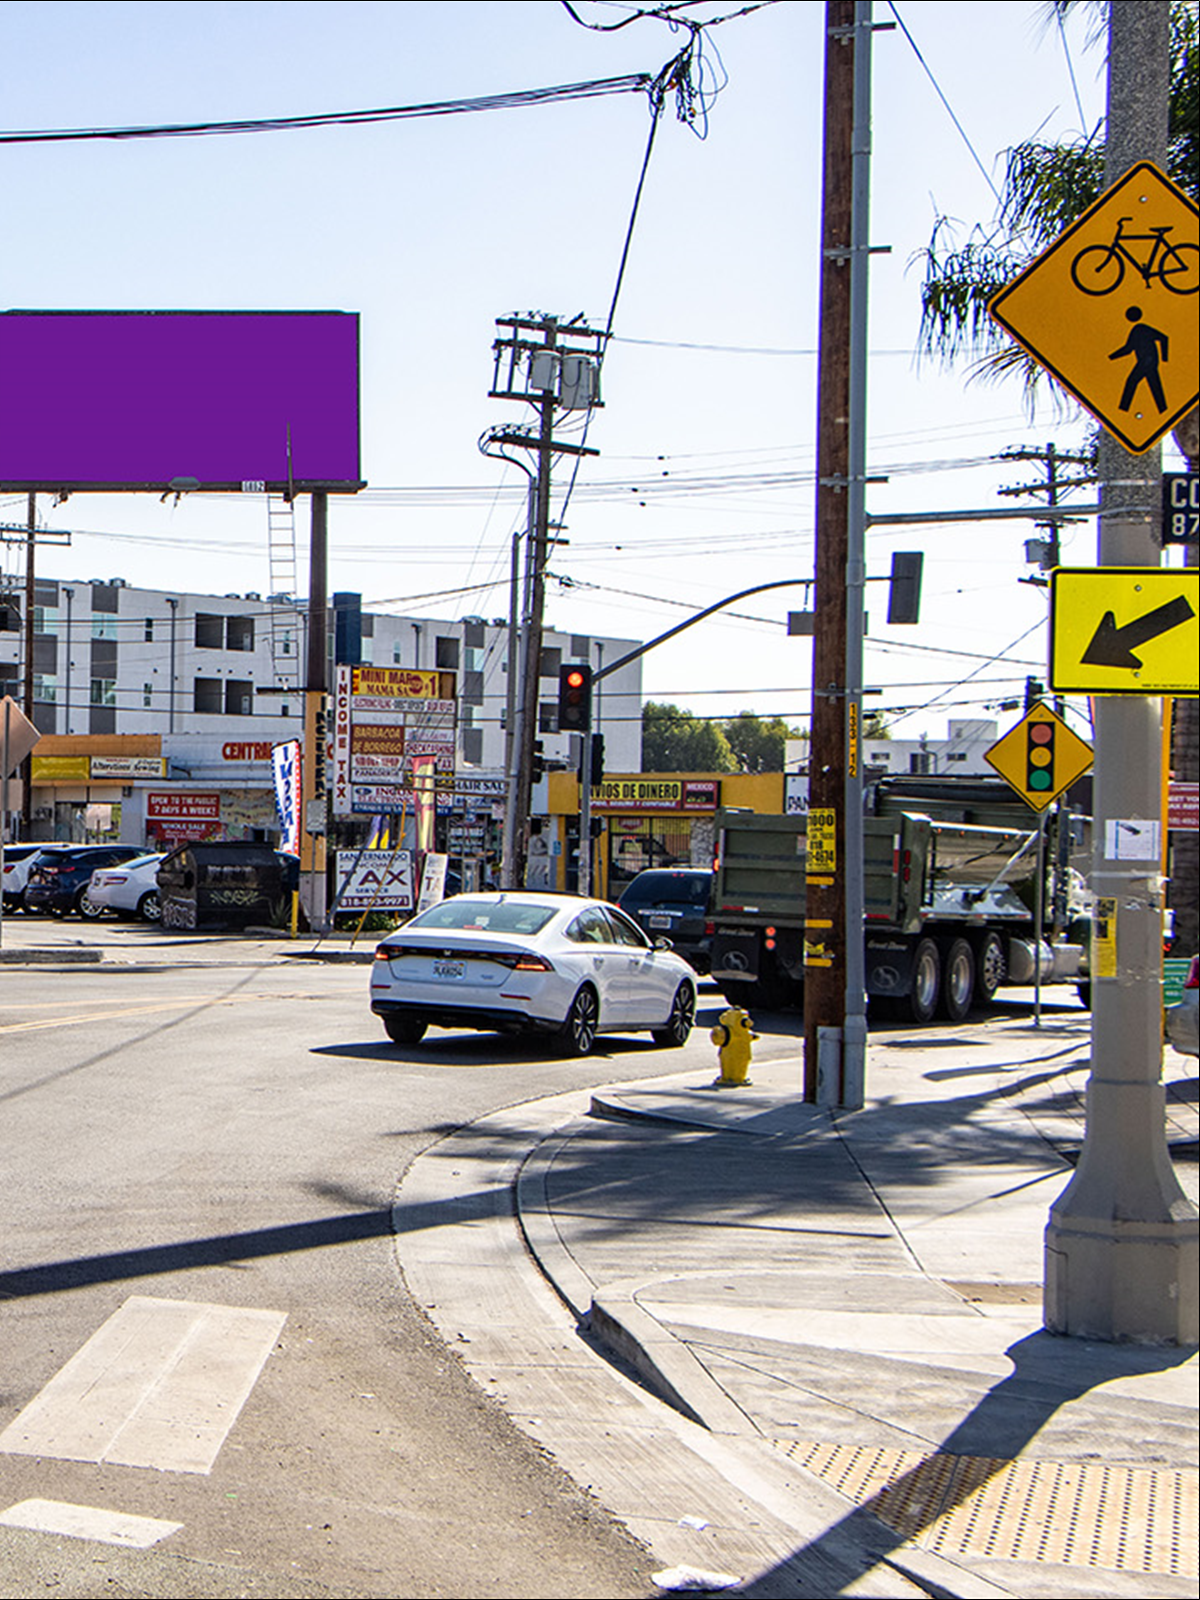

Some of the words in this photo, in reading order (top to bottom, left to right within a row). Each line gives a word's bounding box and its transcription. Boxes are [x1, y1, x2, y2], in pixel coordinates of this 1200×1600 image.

[361, 670, 385, 683] MINI
[337, 670, 347, 748] INCOME
[354, 727, 401, 739] BARBACOA
[222, 742, 272, 760] CENTRA
[336, 760, 346, 798] TAX
[622, 783, 636, 799] DE
[638, 783, 679, 799] DINERO
[686, 782, 714, 791] MEXICO
[151, 796, 167, 804] OPEN
[171, 796, 180, 804] TO
[154, 806, 160, 814] 7
[161, 806, 179, 815] DAYS
[182, 807, 188, 815] A
[161, 823, 186, 831] WHOLE
[188, 823, 206, 831] SALE
[339, 870, 408, 886] TAX
